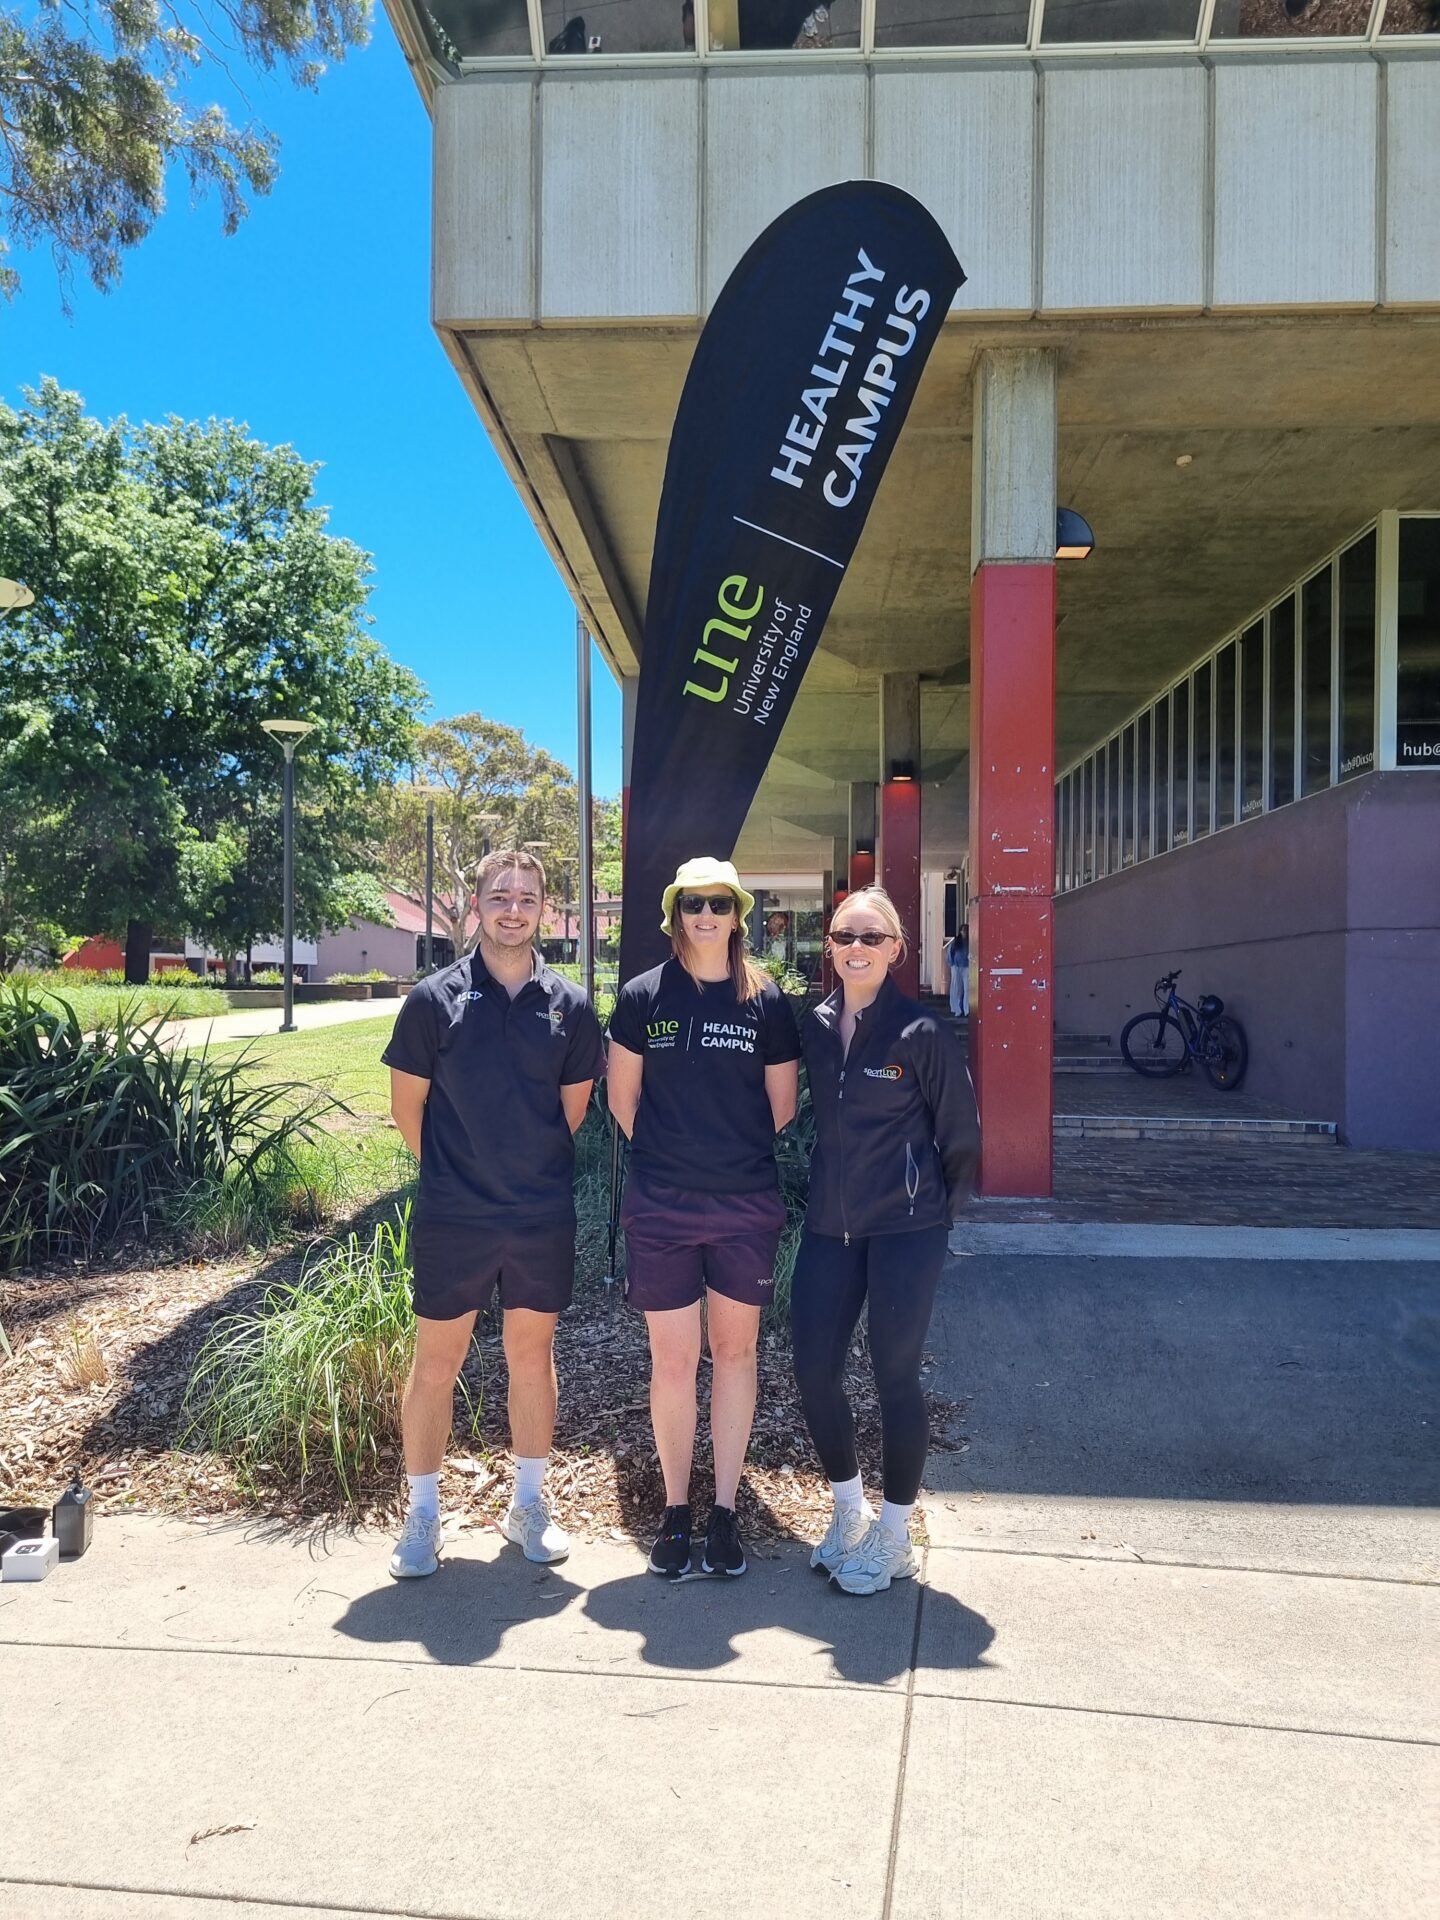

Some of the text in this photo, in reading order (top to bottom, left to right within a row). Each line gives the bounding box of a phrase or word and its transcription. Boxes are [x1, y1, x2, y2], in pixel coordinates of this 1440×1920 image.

[770, 247, 886, 489] HEALTHY
[822, 284, 931, 507] CAMPUS
[733, 596, 793, 715] University of
[753, 604, 812, 725] New England
[701, 1036, 755, 1053] CAMPUS
[703, 1022, 758, 1040] HEALTHY
